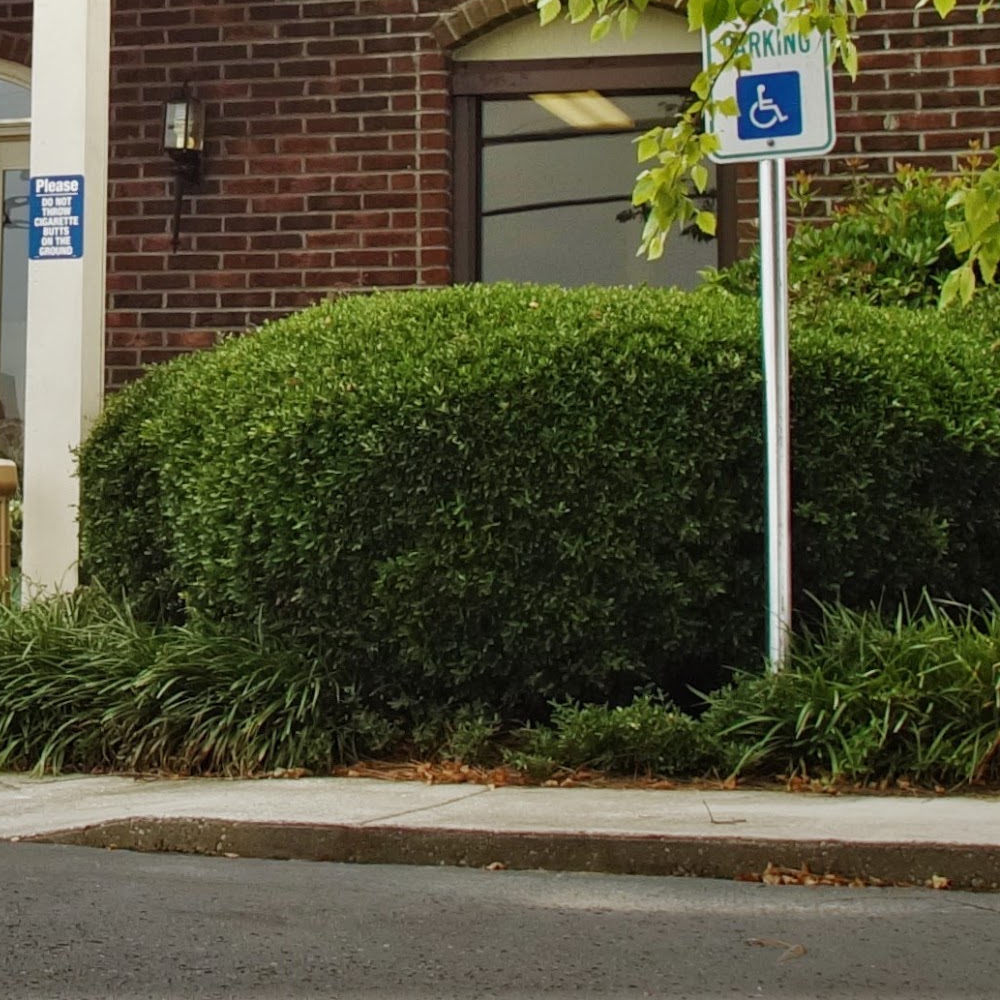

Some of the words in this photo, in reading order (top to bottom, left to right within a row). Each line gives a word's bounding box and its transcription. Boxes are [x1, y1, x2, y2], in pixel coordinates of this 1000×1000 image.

[723, 29, 810, 58] RKING
[35, 178, 79, 193] Please
[41, 197, 53, 207] DO
[55, 196, 72, 206] NOT
[42, 206, 72, 216] THROW
[33, 216, 79, 227] CIGARETTE
[43, 226, 70, 236] BUTTS
[41, 236, 53, 246] ON
[55, 236, 71, 246] THE
[39, 246, 73, 256] GROUND
